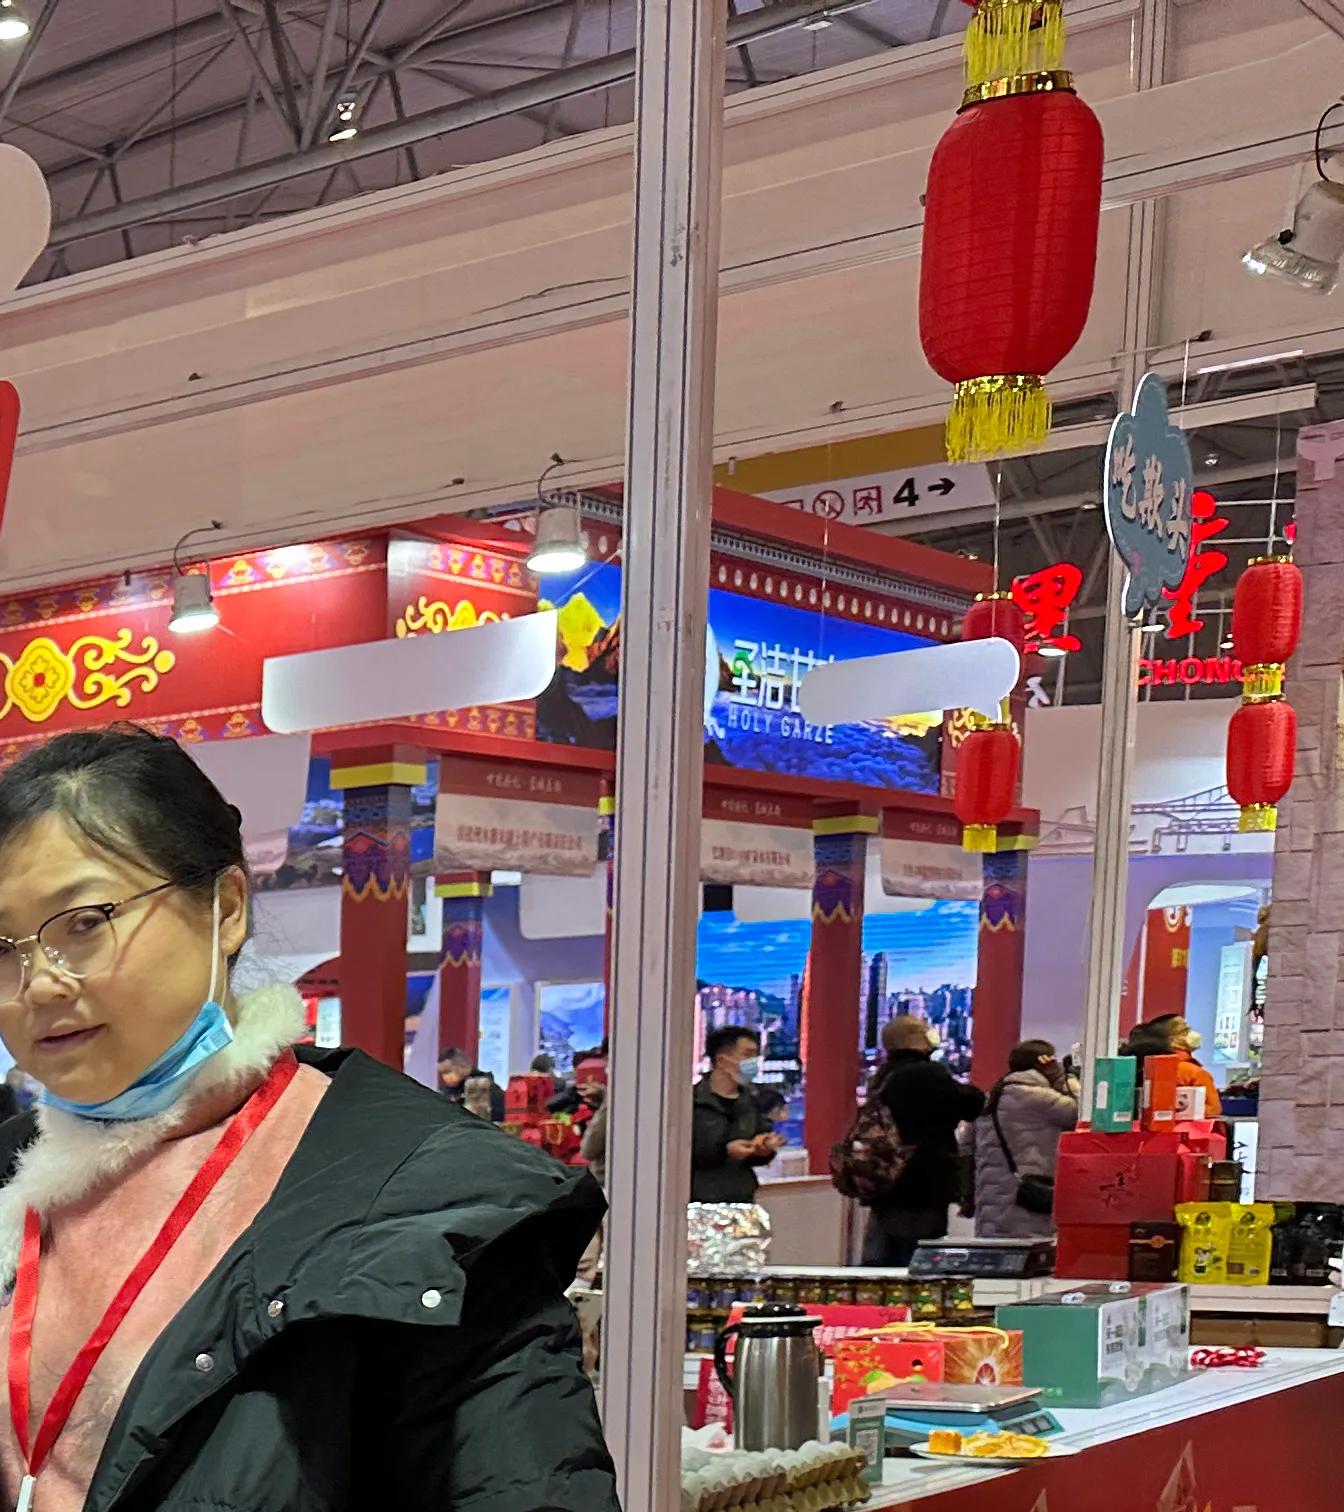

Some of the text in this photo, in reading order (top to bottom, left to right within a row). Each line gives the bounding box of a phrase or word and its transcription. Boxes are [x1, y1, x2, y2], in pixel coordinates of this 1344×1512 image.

[893, 476, 920, 508] 4
[726, 706, 835, 745] HOLY GARZE
